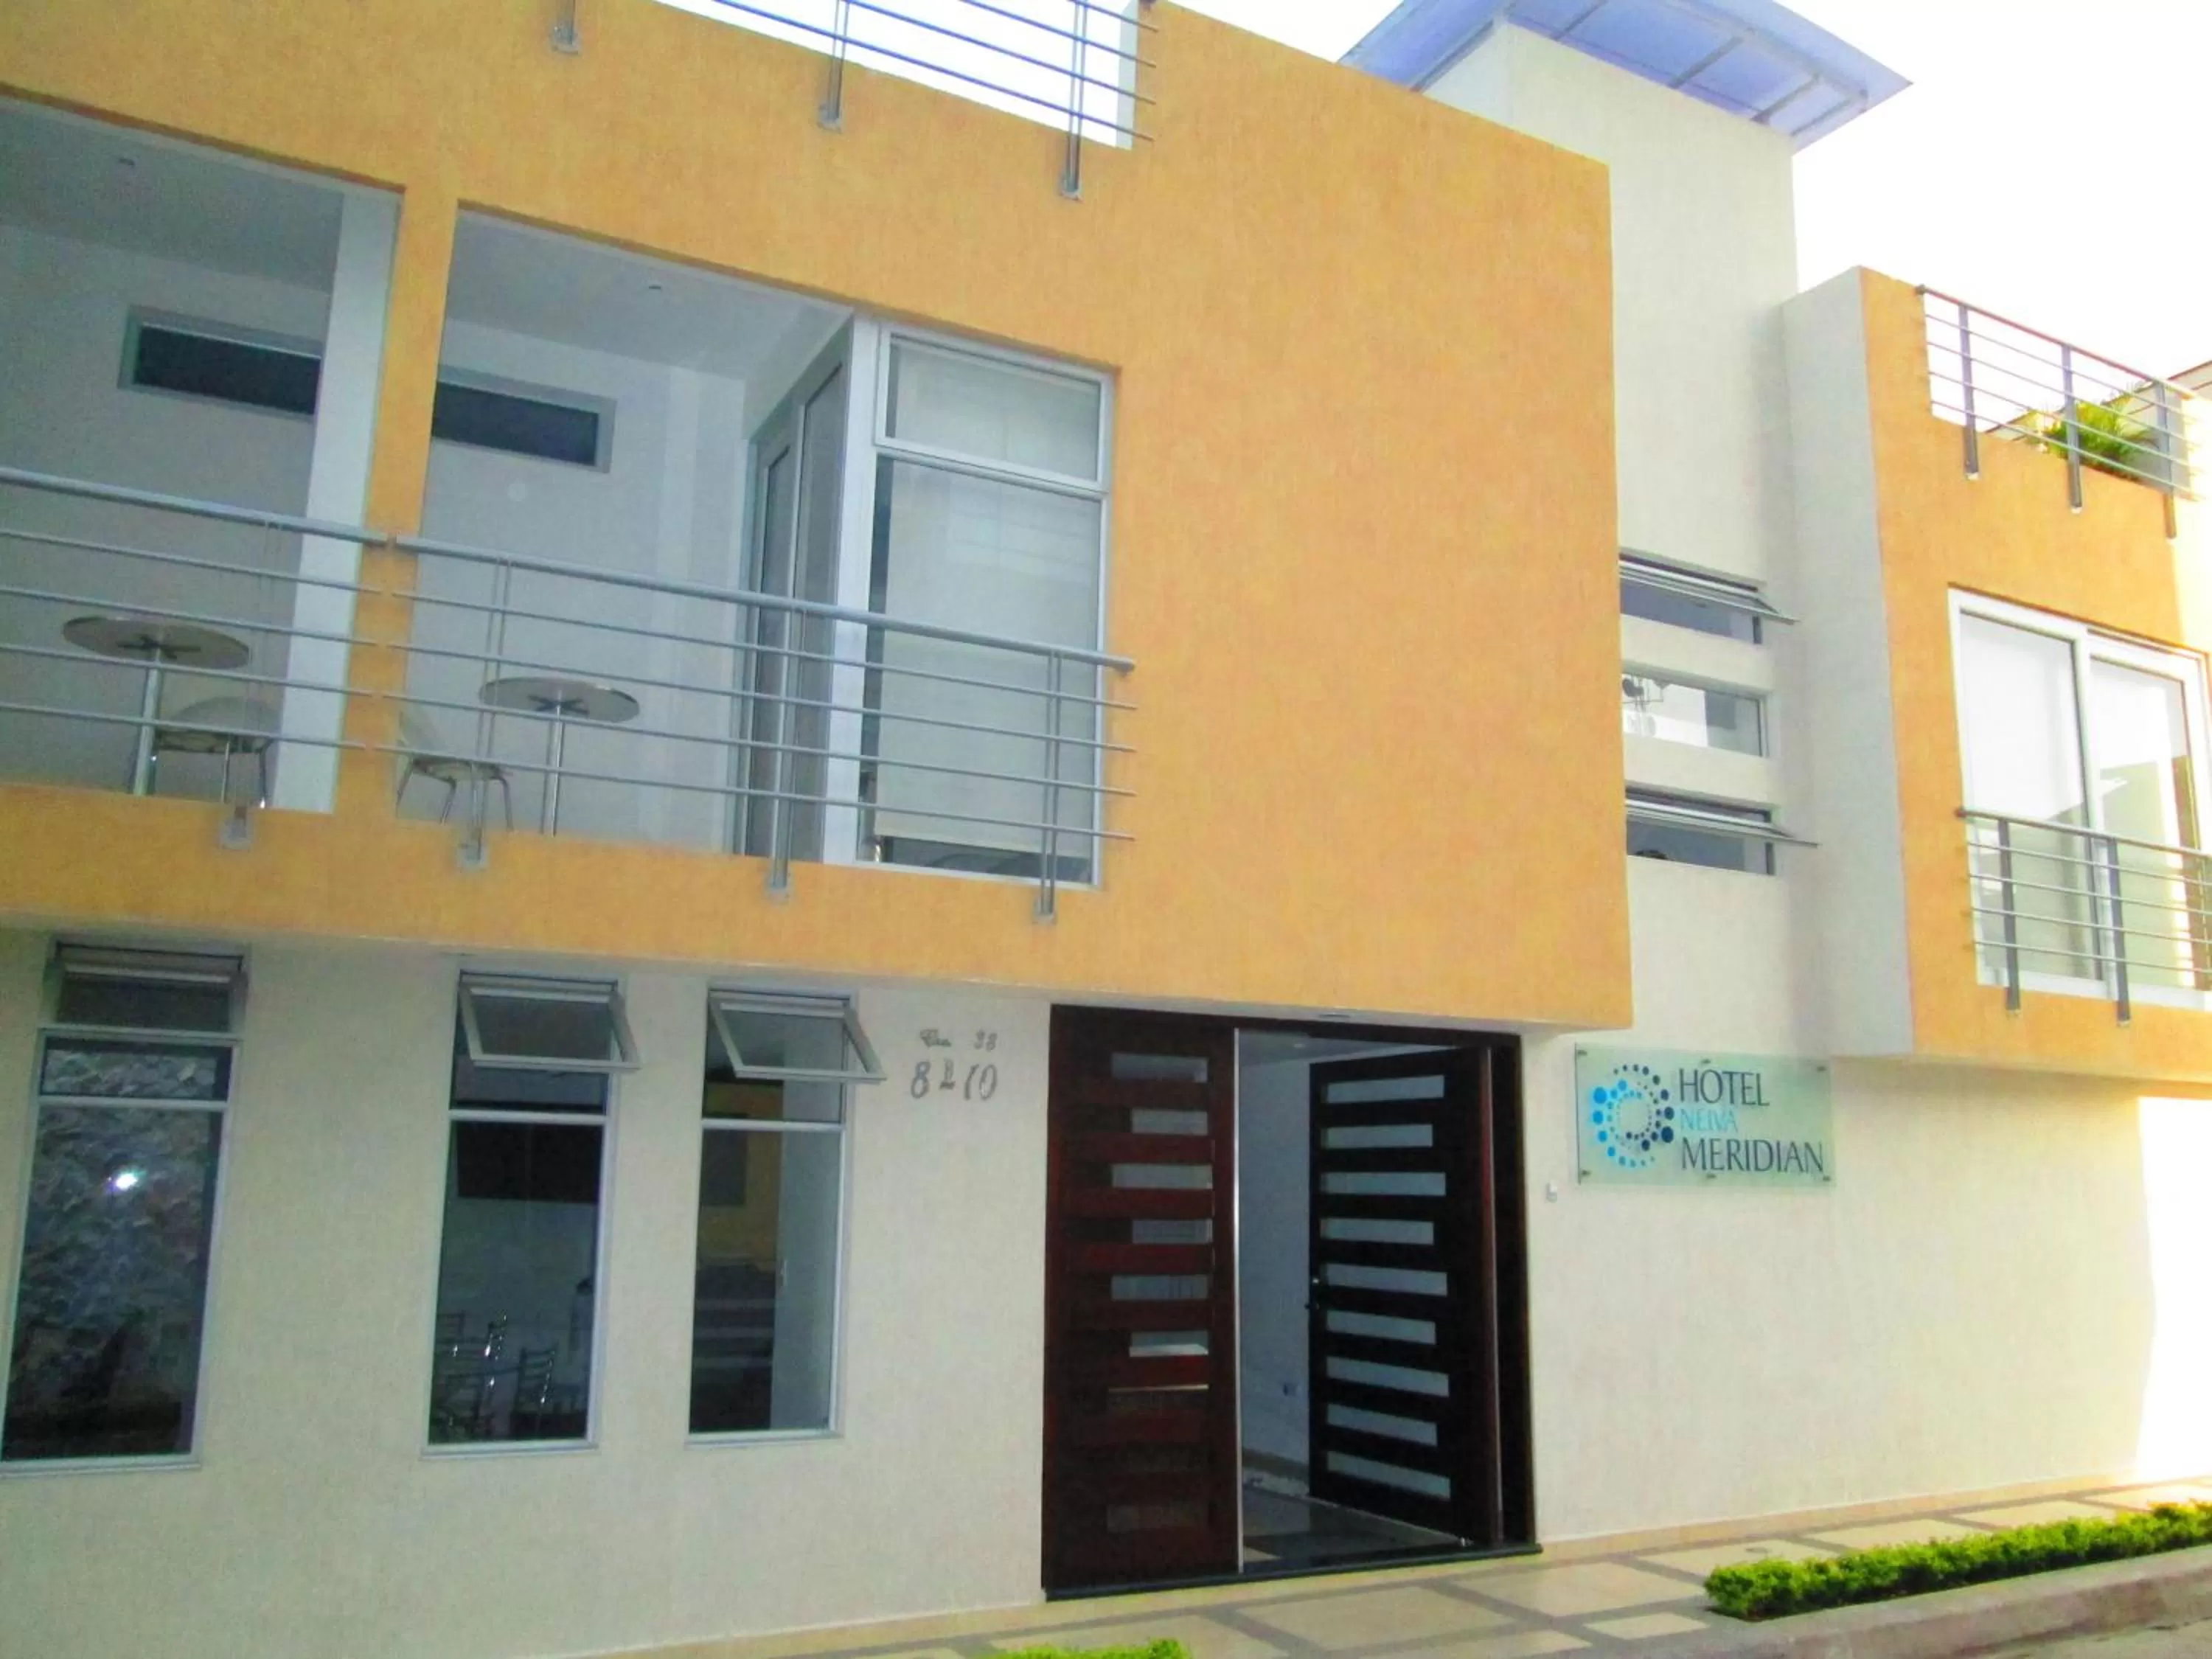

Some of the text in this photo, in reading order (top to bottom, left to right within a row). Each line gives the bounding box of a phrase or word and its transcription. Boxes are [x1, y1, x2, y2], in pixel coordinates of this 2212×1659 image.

[1678, 1067, 1770, 1107] HOTEL
[1680, 1107, 1739, 1132] NEIVA
[1681, 1136, 1824, 1173] MERIDIAN
